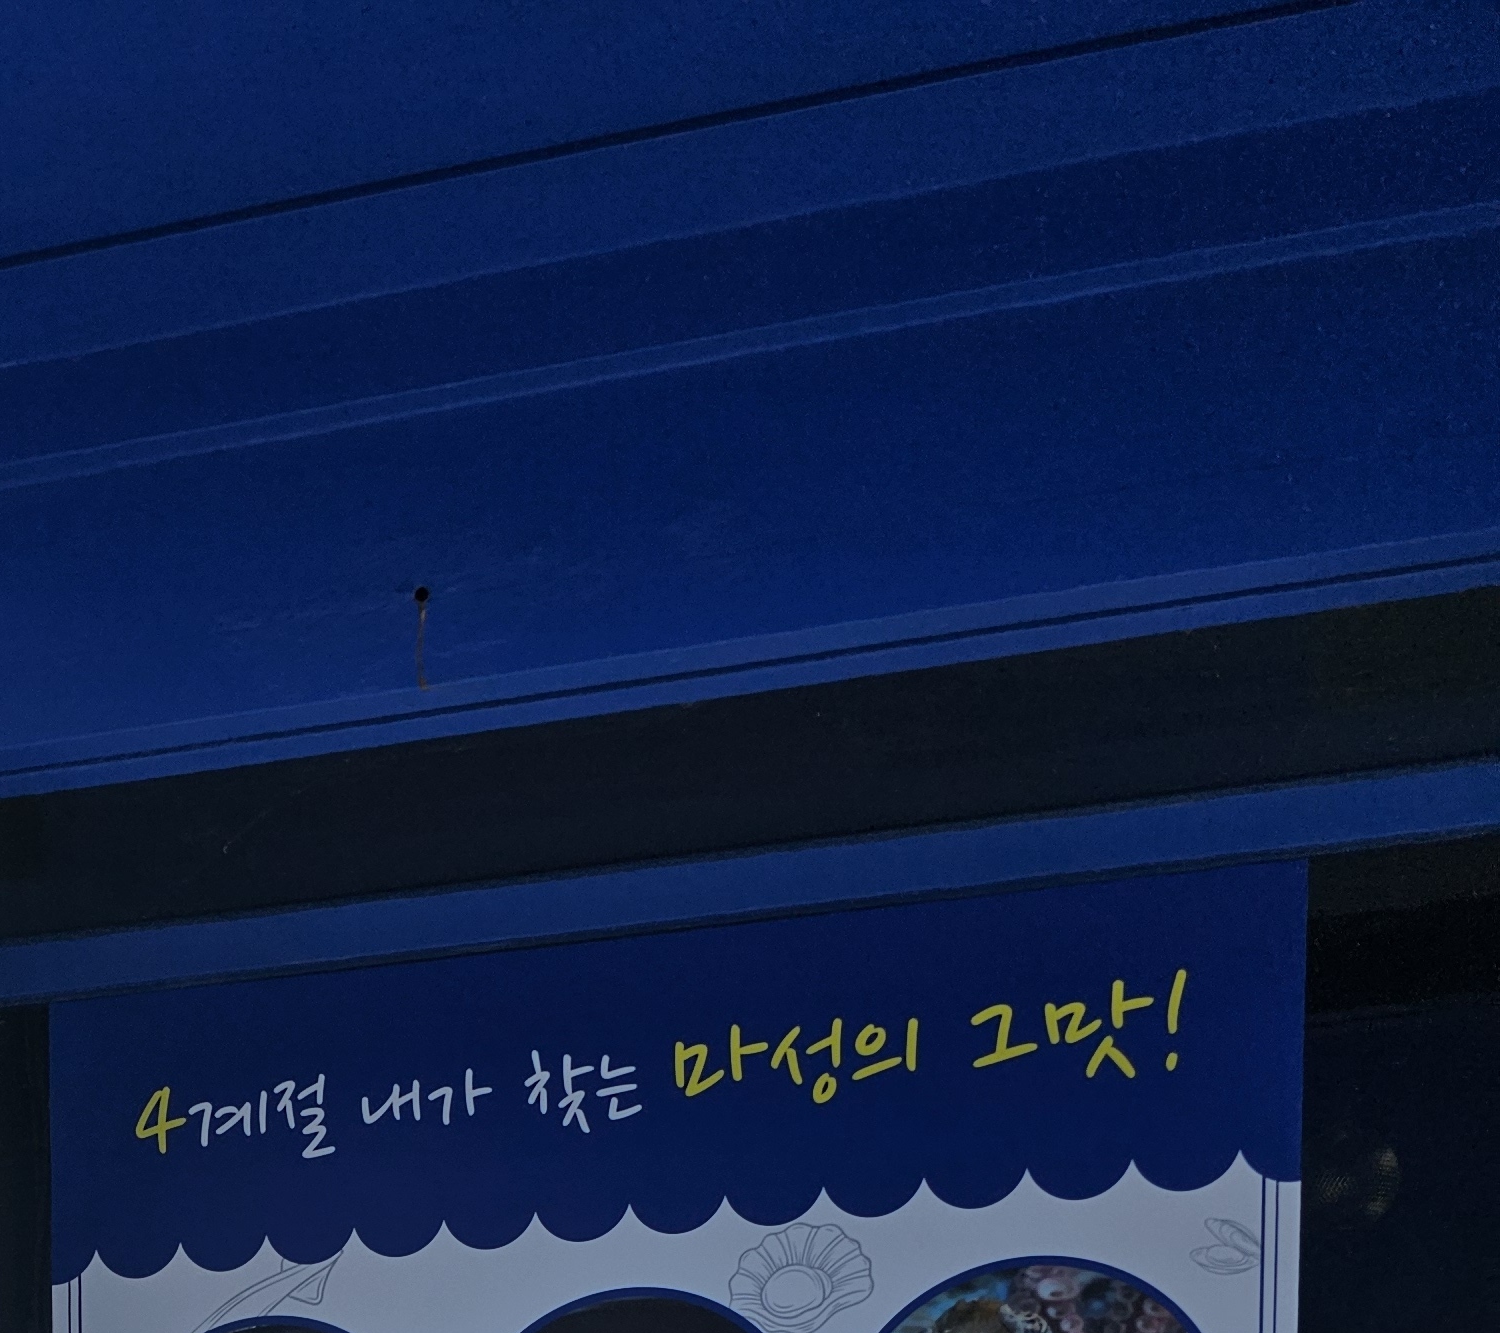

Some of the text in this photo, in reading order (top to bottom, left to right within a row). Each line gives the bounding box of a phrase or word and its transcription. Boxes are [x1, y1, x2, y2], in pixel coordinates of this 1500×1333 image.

[135, 1073, 336, 1160] 4계절
[361, 1068, 493, 1126] 내가
[524, 1049, 643, 1134] 찾는
[674, 1017, 920, 1104] 마성의
